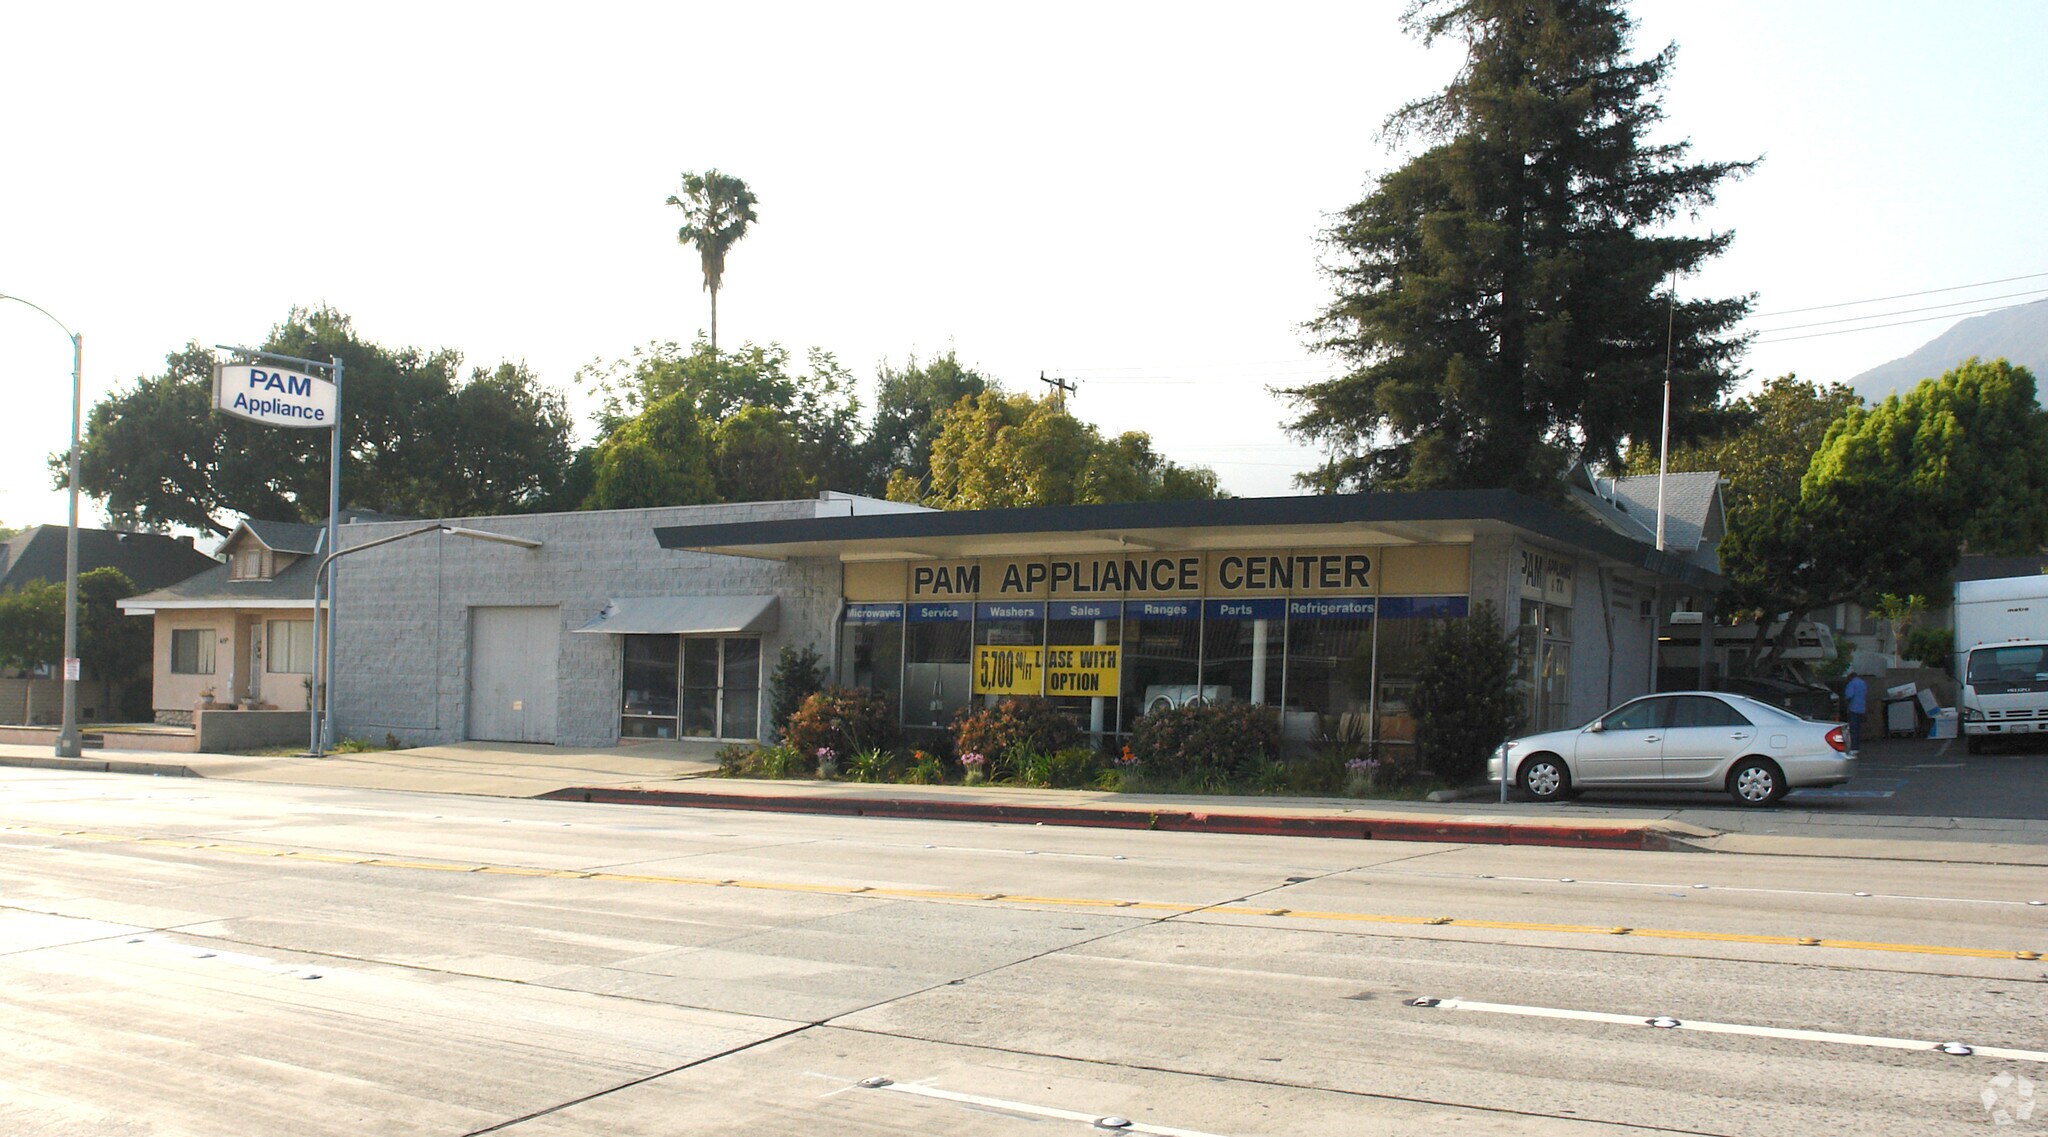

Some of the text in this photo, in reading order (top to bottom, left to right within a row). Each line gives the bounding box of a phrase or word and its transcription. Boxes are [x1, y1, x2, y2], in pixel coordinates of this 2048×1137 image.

[249, 368, 312, 397] PAM
[233, 392, 325, 421] Appliance
[914, 554, 1371, 594] PAM APPLIANCE CENTER
[846, 607, 901, 618] Microwaves
[921, 607, 959, 618] Service
[990, 606, 1035, 617] Washers
[1070, 605, 1100, 616] Sales
[1144, 604, 1187, 616] Ranges
[1220, 604, 1253, 615] Parts
[1290, 602, 1375, 616] Refrigerators
[1035, 650, 1116, 668] LASE WITH
[980, 650, 1014, 690] 5,700
[1050, 672, 1099, 691] OPTION
